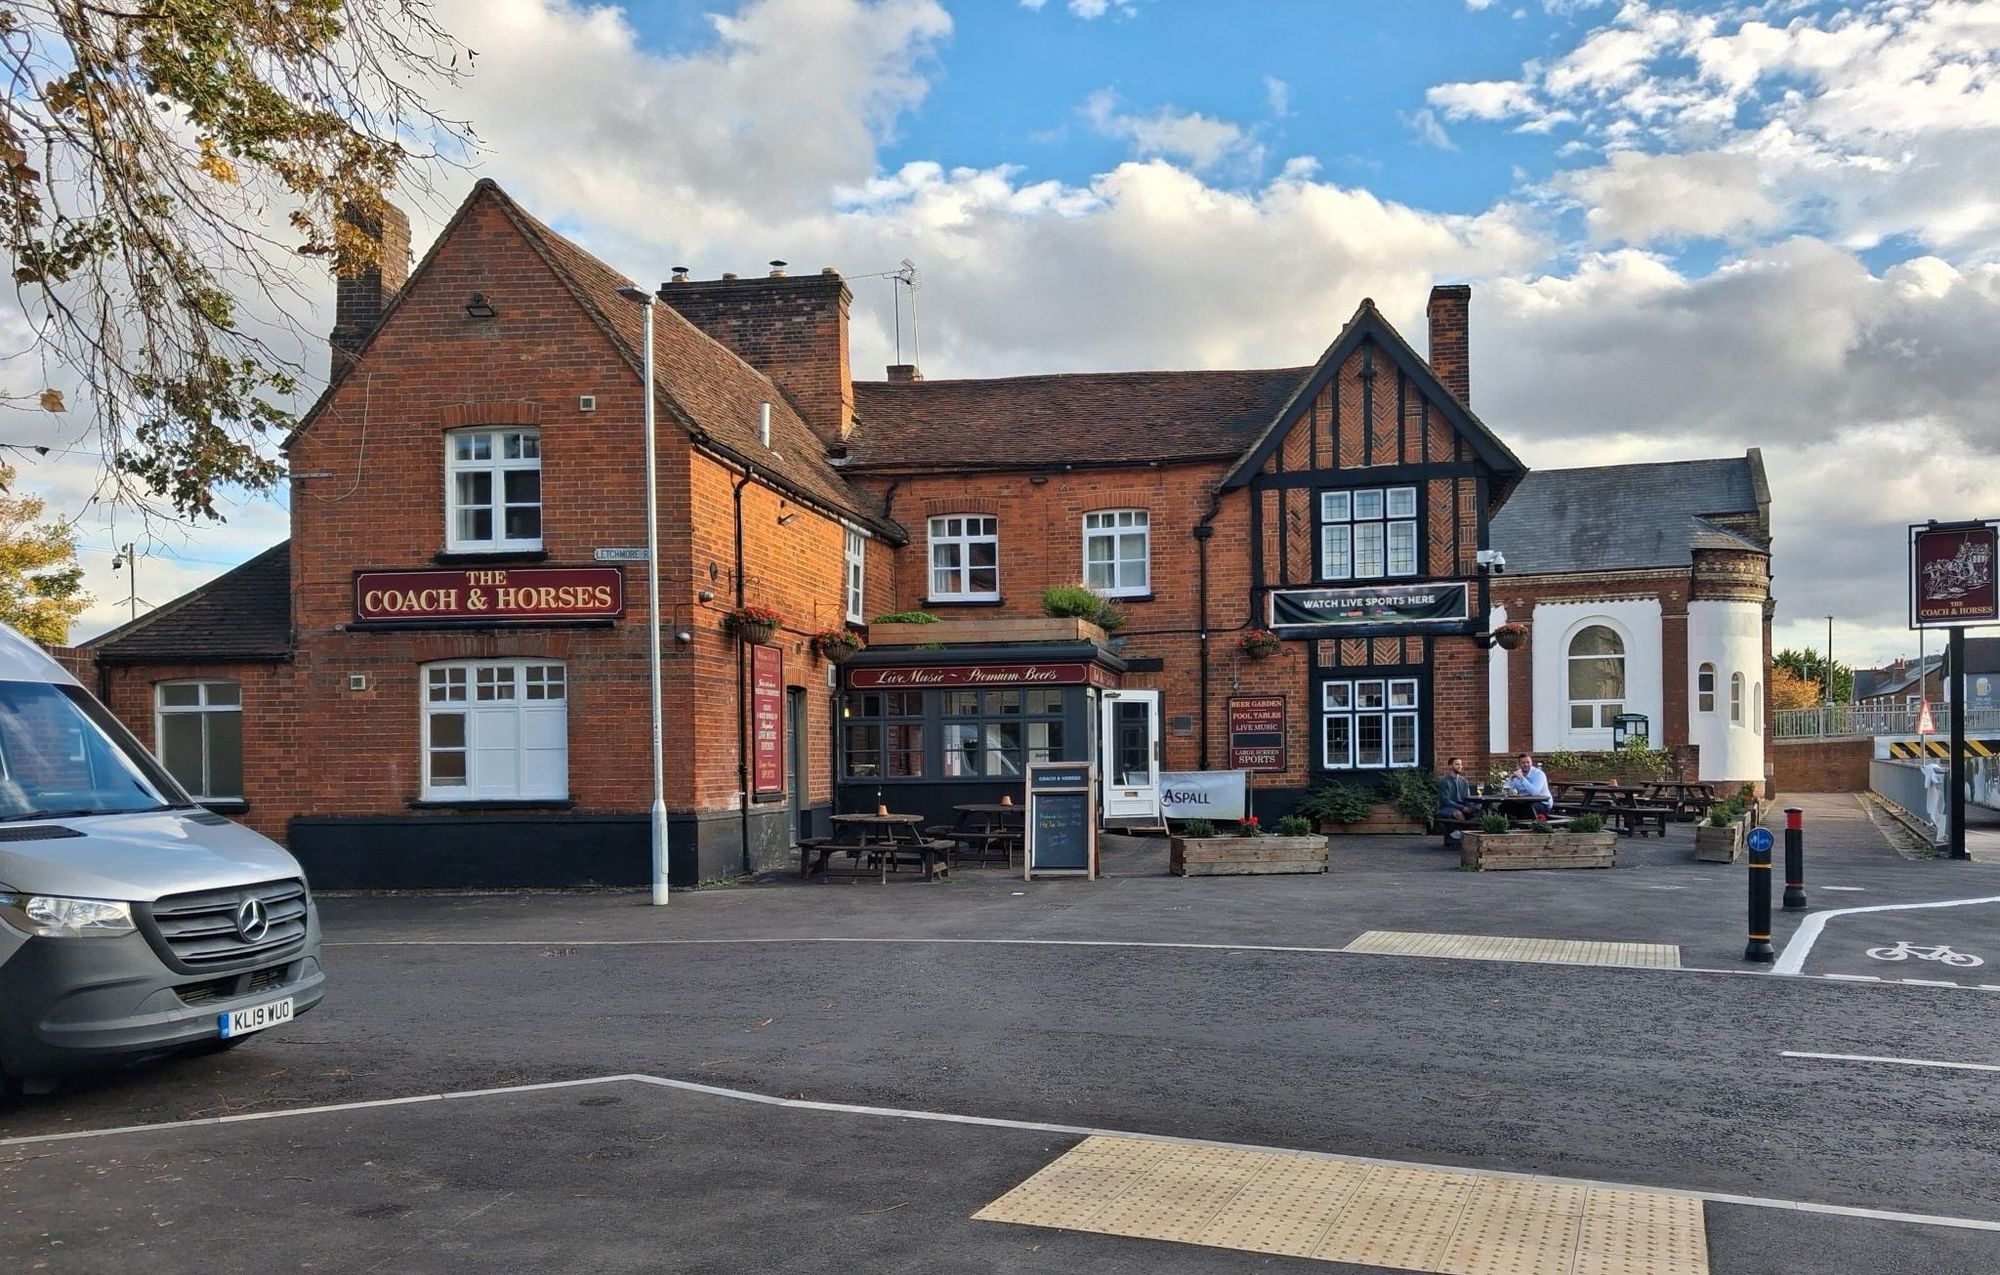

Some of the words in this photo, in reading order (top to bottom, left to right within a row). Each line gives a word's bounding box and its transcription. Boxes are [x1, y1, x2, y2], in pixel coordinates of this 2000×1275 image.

[596, 550, 639, 559] LETCHMORE
[466, 571, 507, 586] THE
[365, 589, 458, 612] COACH
[466, 589, 488, 610] &
[496, 586, 612, 609] HORSES
[1303, 598, 1338, 609] WATCH
[1341, 597, 1363, 608] LIVE
[1365, 596, 1405, 607] SPORTS
[1408, 594, 1436, 605] HERE
[1921, 608, 1949, 617] COACH
[1951, 608, 1958, 616] &
[1959, 606, 1993, 615] HORSES
[875, 670, 905, 684] Live
[903, 669, 945, 683] Music
[963, 668, 1021, 682] Premium
[1020, 666, 1058, 681] Beers
[1251, 700, 1282, 708] GARDEN
[1238, 755, 1276, 764] SPORTS
[1161, 788, 1210, 807] ASPALL
[234, 1008, 264, 1031] KL19
[268, 1001, 289, 1022] WUO
